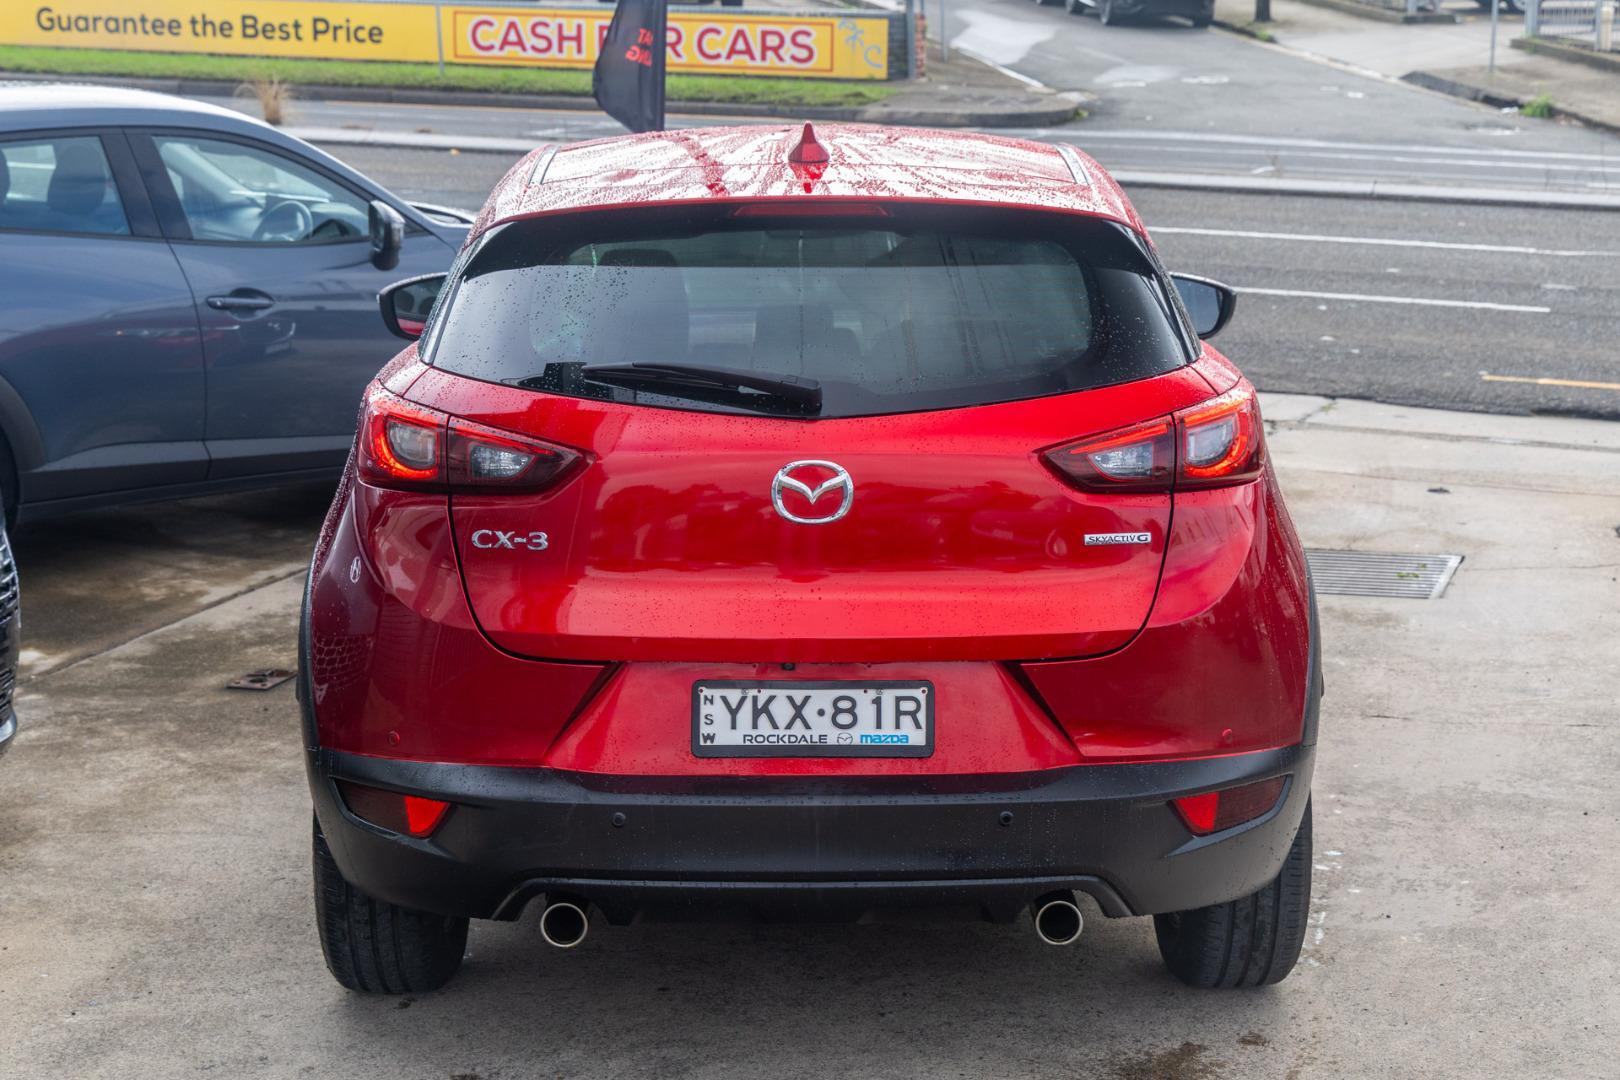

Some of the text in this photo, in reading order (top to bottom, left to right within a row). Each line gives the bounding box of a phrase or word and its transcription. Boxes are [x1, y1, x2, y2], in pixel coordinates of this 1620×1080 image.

[36, 7, 384, 44] Guarantee the Best Price
[470, 19, 584, 56] CASH
[697, 27, 817, 65] CARS
[471, 529, 549, 550] CX-3
[743, 734, 828, 745] ROCKDALE
